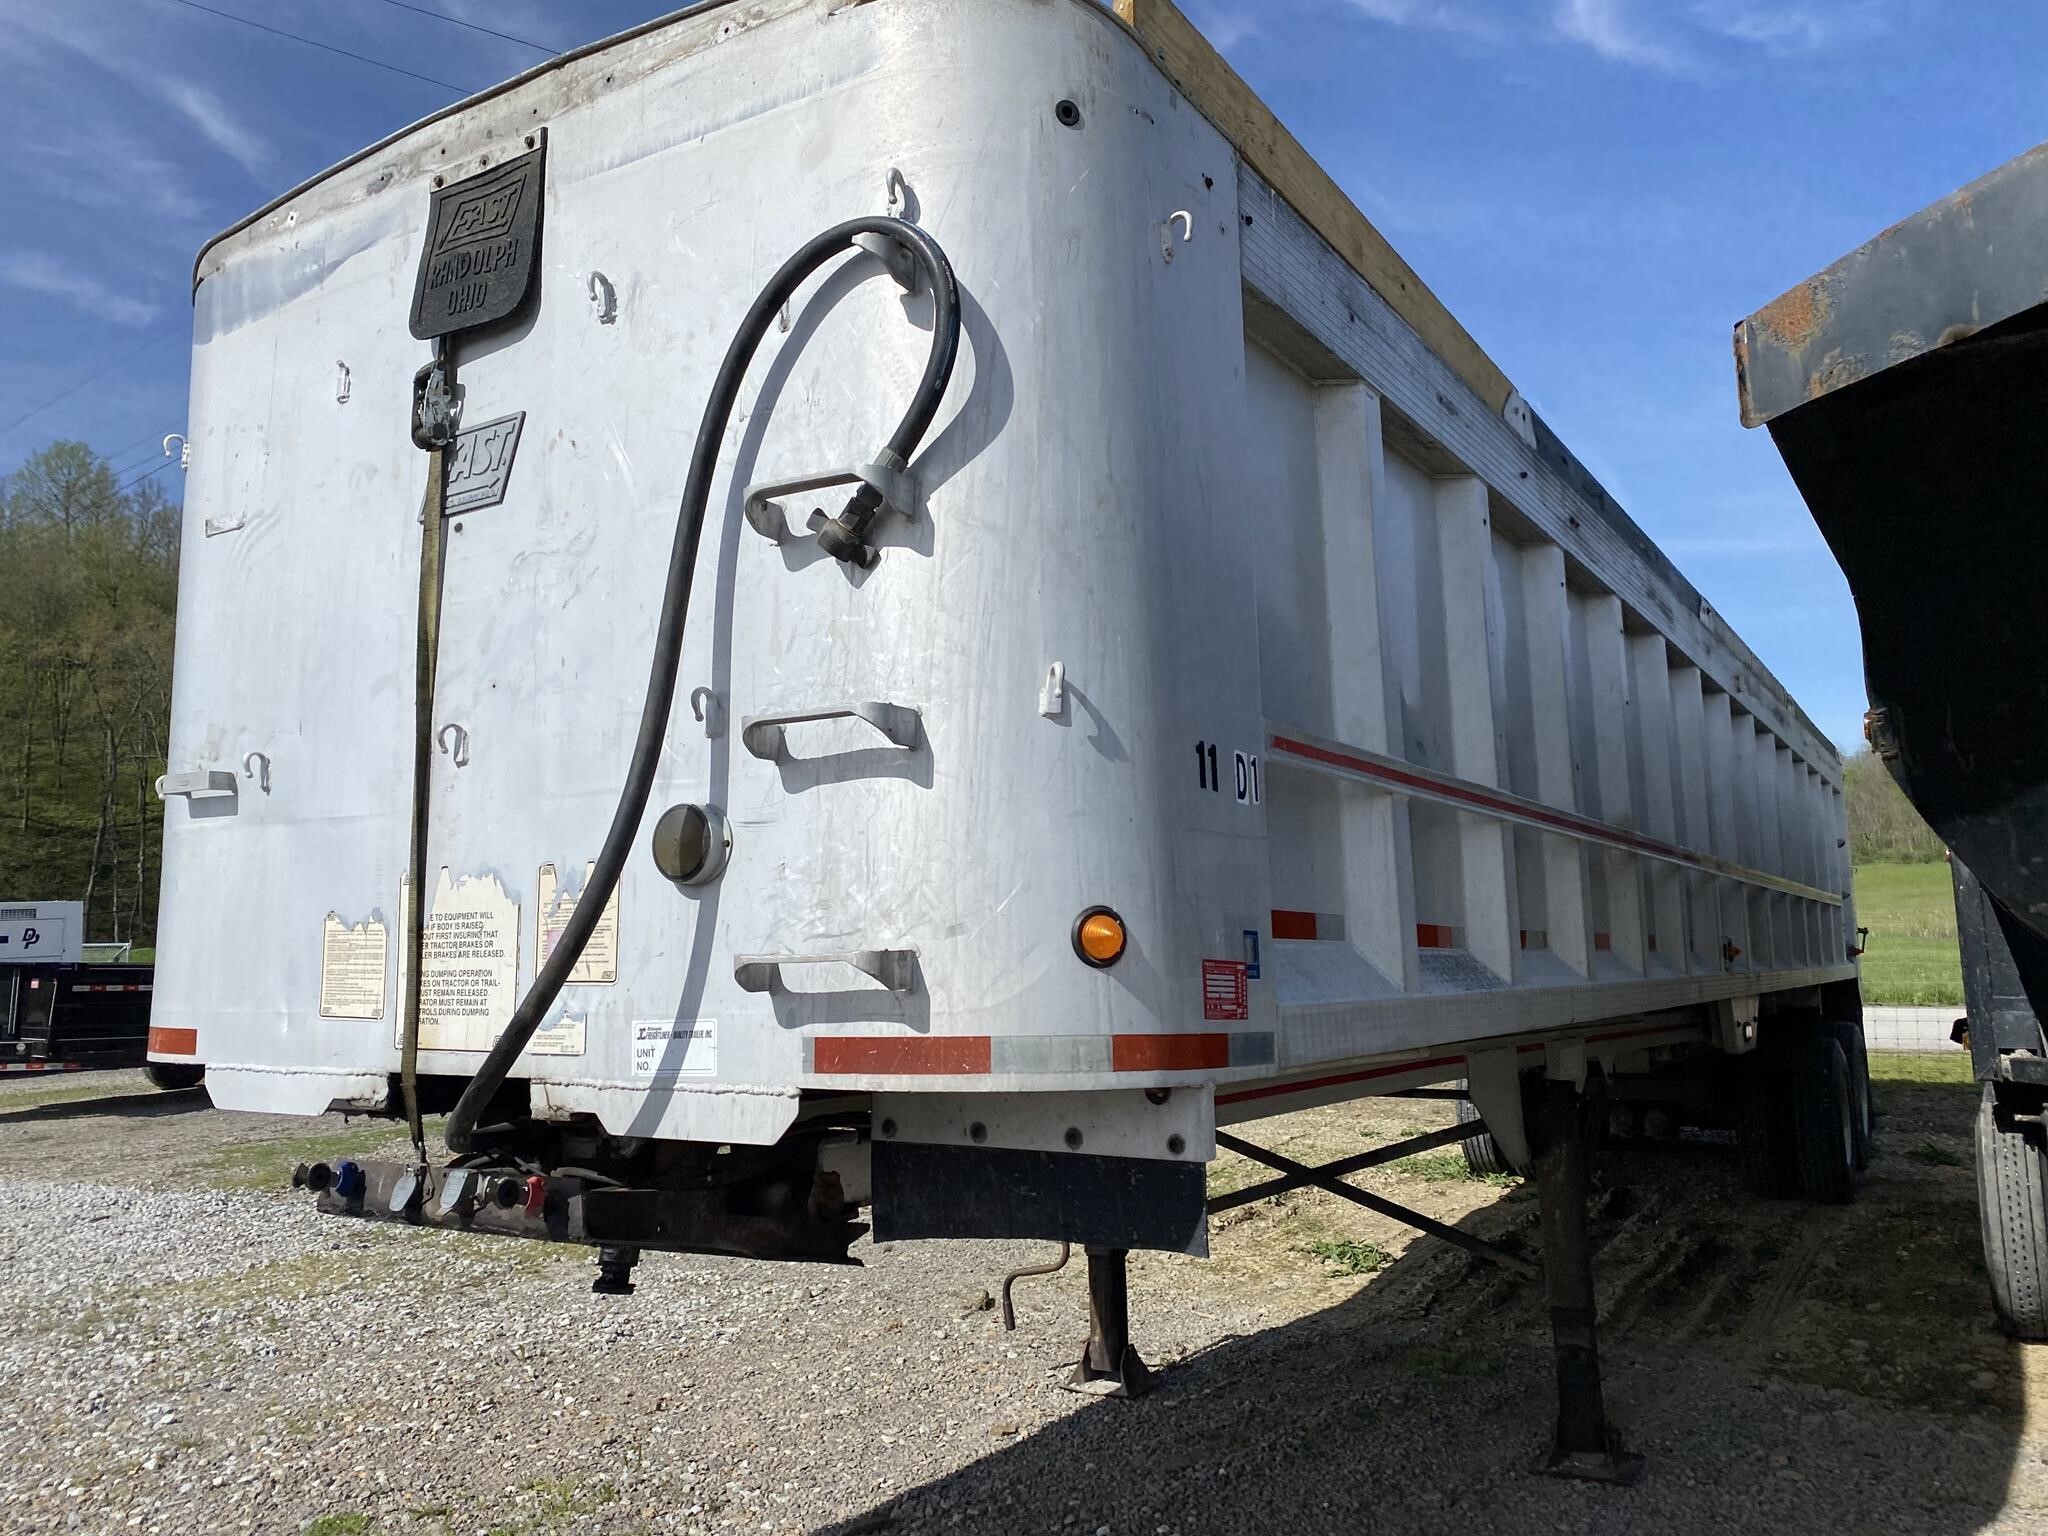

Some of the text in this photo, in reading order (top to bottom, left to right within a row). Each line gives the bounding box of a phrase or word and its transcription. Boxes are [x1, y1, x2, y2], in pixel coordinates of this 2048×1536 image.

[453, 188, 518, 236] EAST
[430, 238, 519, 289] RANDOLPH
[448, 281, 488, 316] OHIO
[1196, 740, 1259, 802] 11 D1
[444, 912, 478, 920] EQUIPMENT
[479, 911, 494, 919] WILL
[437, 922, 453, 930] BODY
[454, 922, 460, 930] IS
[435, 932, 452, 940] FIRST
[453, 931, 482, 939] INSURING
[483, 930, 499, 938] THAT
[430, 941, 457, 949] TRACTOR
[459, 940, 483, 949] BRAKES
[484, 940, 494, 948] OR
[433, 950, 457, 959] BRAKES
[458, 950, 471, 958] ARE
[471, 949, 506, 958] RELEASED.
[430, 970, 457, 978] DUMPING
[458, 969, 493, 978] OPERATION
[442, 979, 470, 987] TRACTOR
[470, 979, 480, 987] OR
[433, 988, 455, 996] REMAIN
[438, 998, 454, 1006] MUST
[455, 998, 479, 1006] REMAIN
[479, 998, 488, 1006] AT
[438, 1008, 460, 1016] DURING
[461, 1008, 489, 1016] DUMPING
[636, 1048, 656, 1058] UNIT
[636, 1061, 651, 1071] NO.
